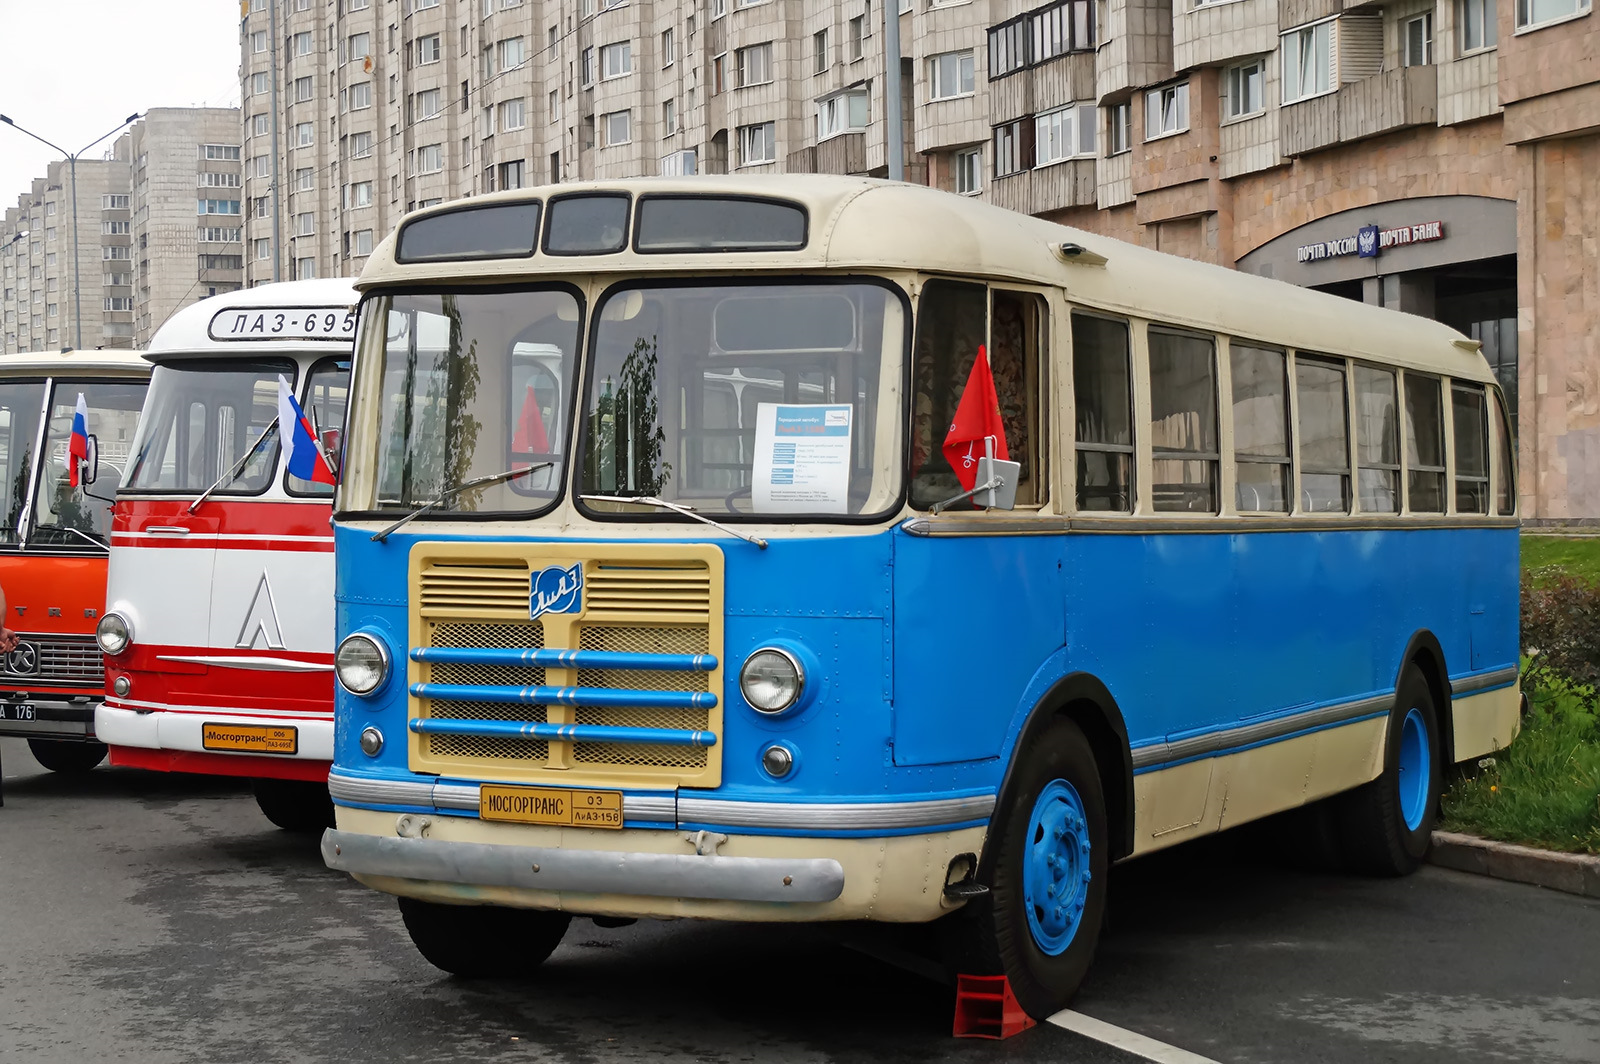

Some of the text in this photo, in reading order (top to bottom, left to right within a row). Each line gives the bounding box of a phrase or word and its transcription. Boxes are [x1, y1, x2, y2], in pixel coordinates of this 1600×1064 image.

[1379, 221, 1442, 249] ПОЧТА БАНК
[1297, 236, 1358, 262] ПОЧТА РОССИИ
[231, 313, 355, 333] ЛАЗ-695
[15, 706, 32, 719] 176
[208, 731, 266, 744] Мосгортранс
[489, 795, 564, 816] МОСГОРТРАНС
[575, 812, 619, 822] ЛиАЗ-158
